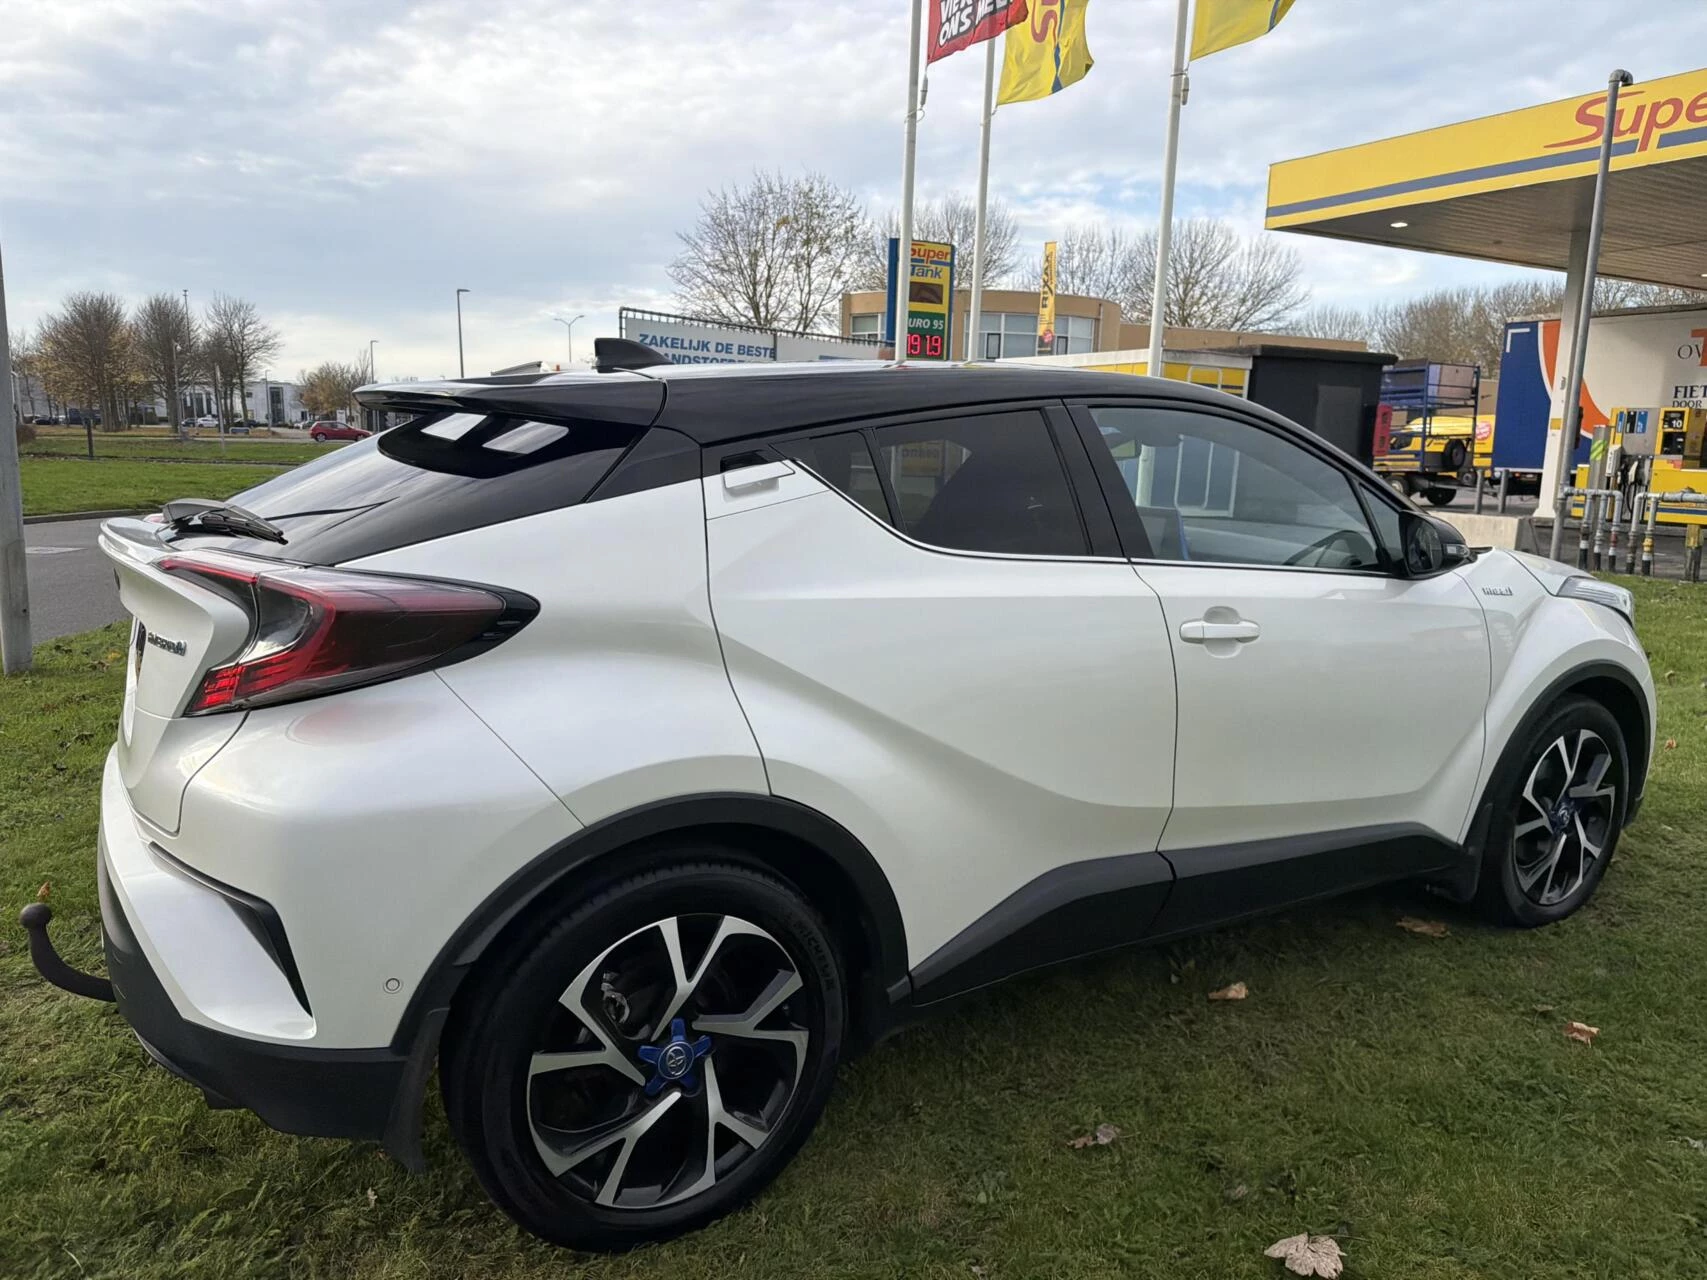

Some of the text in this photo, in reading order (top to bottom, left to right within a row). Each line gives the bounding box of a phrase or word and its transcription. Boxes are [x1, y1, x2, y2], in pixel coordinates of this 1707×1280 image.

[939, 5, 973, 47] ONS
[908, 318, 944, 330] URO 95
[639, 333, 777, 359] ZAKELIJK DE BESTE
[1671, 420, 1683, 429] 10
